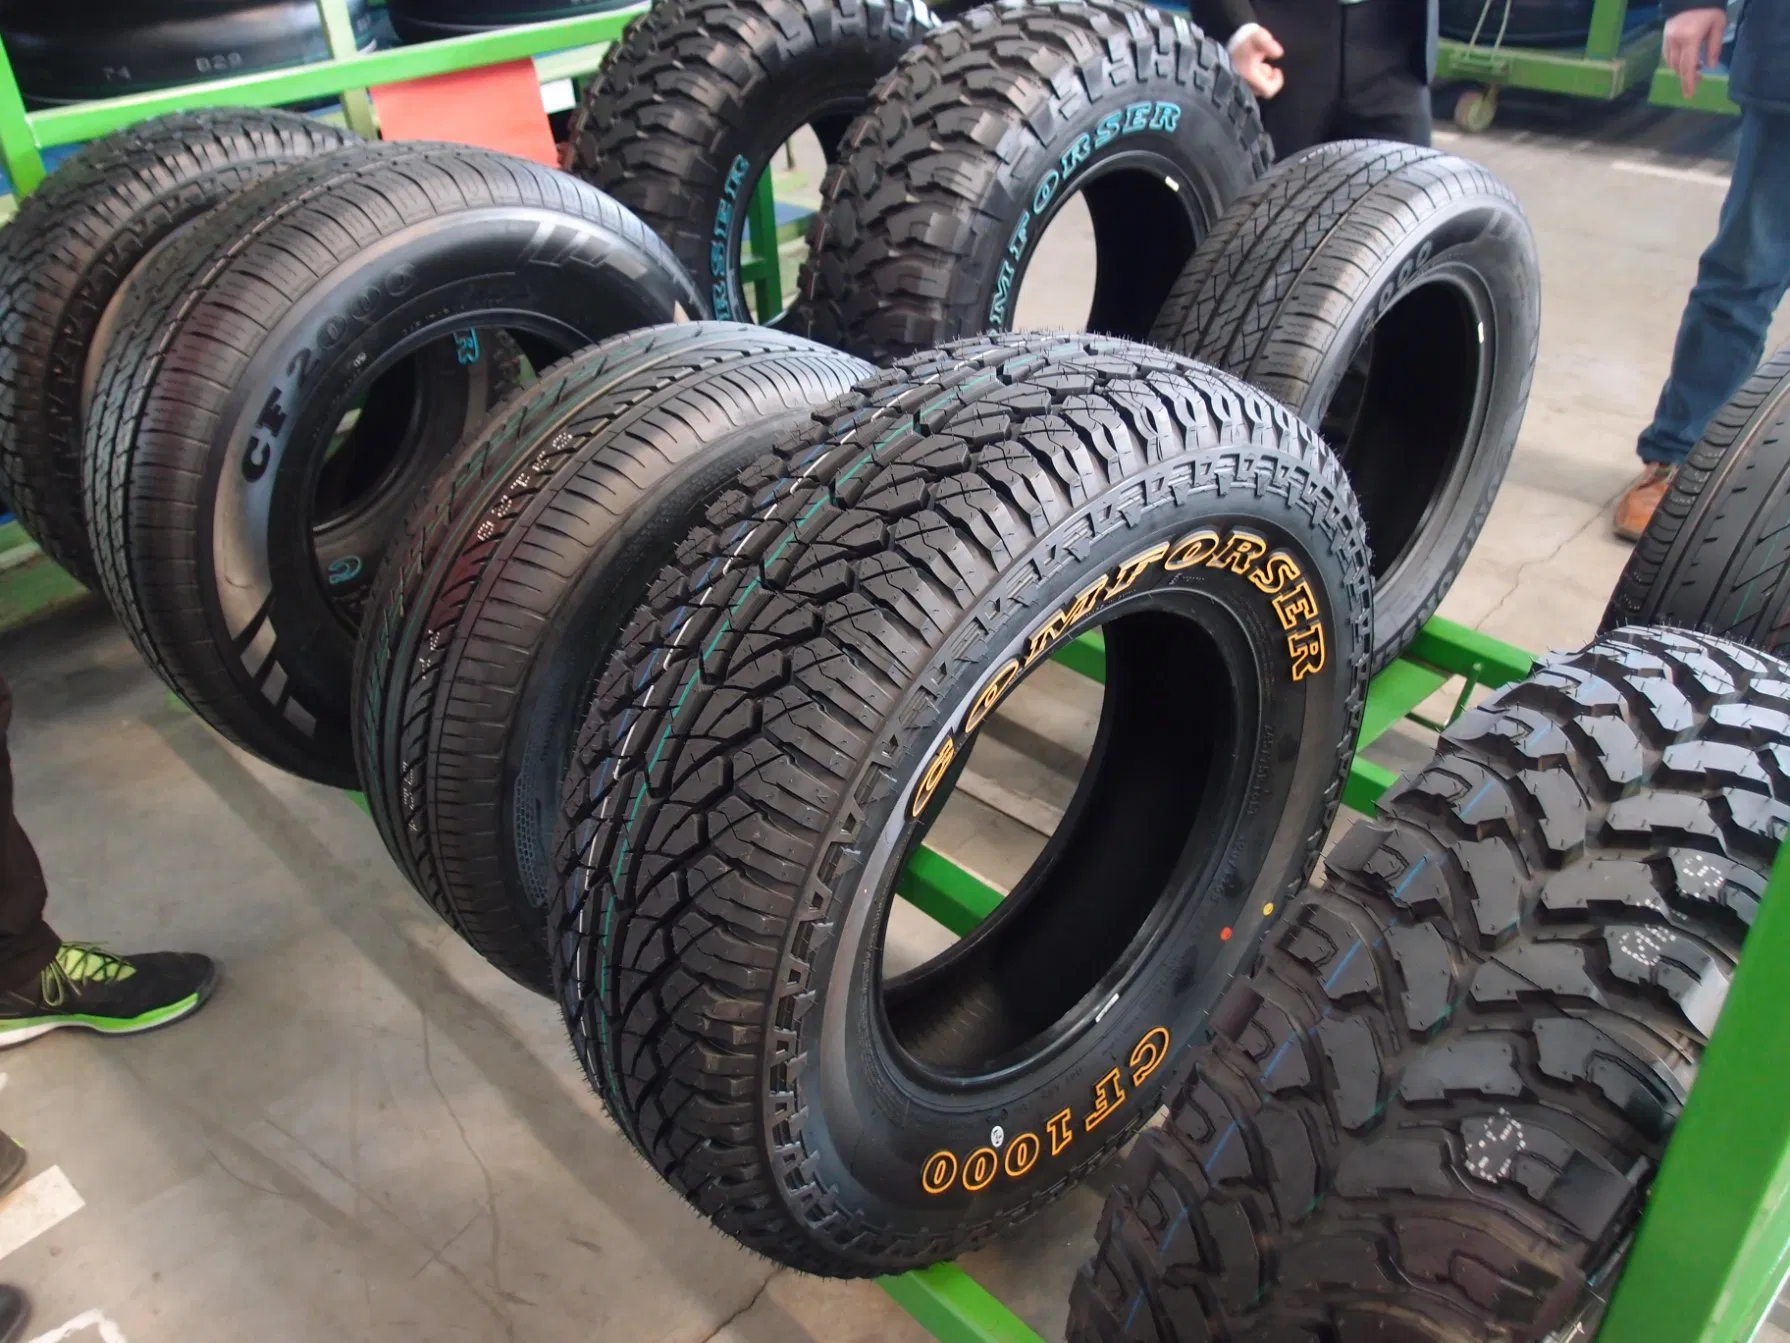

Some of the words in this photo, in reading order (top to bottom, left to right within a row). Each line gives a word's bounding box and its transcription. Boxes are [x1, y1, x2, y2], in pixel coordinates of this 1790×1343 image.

[988, 101, 1181, 337] MFORSER
[912, 529, 1327, 817] COMFORSER
[922, 1027, 1171, 1194] CF1000
